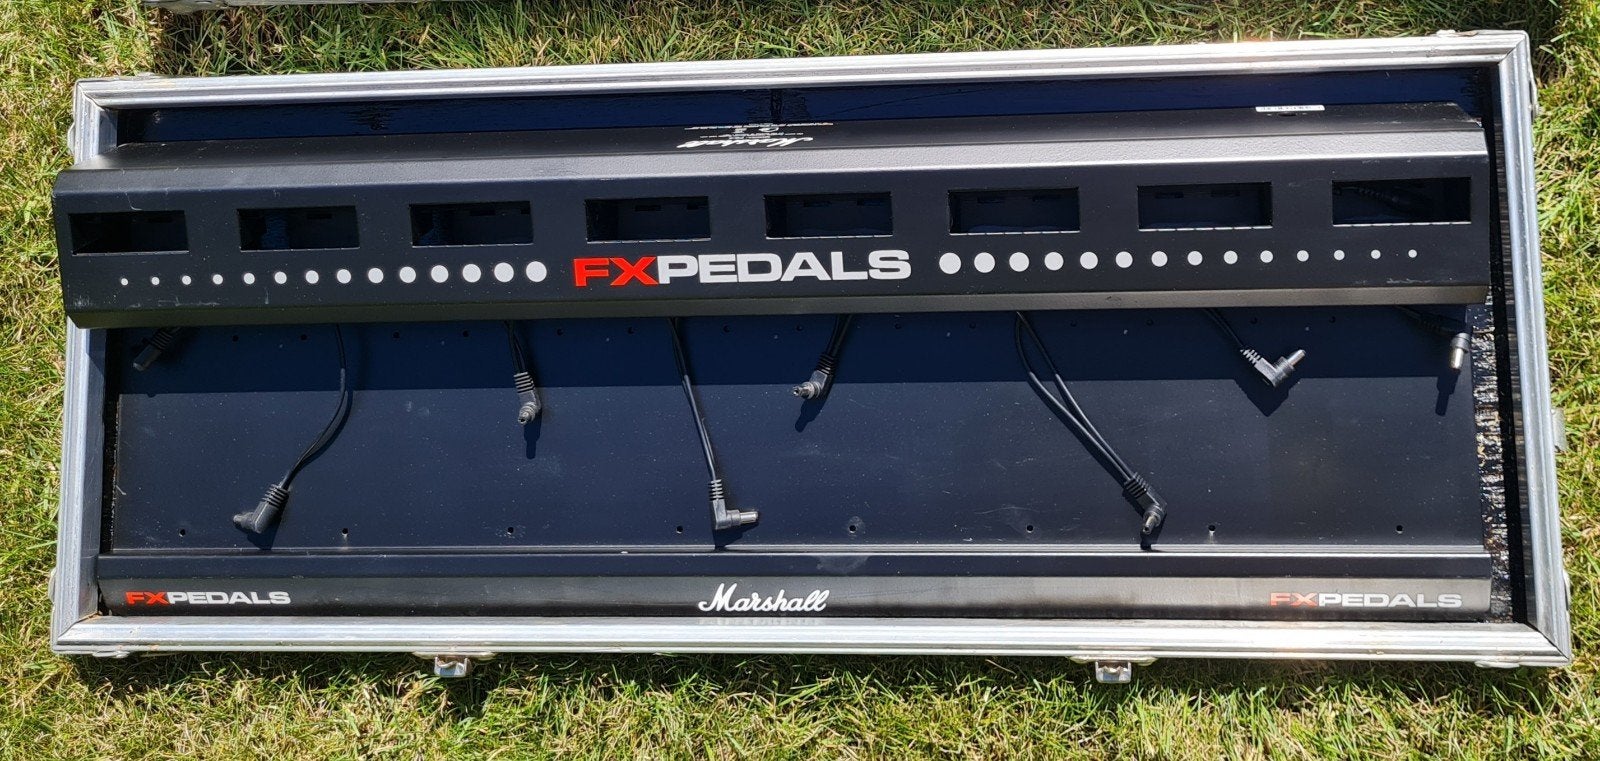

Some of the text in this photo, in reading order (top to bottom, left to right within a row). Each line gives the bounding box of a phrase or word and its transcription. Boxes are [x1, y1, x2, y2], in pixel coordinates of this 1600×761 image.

[574, 249, 911, 286] FXPEDALS
[126, 591, 291, 605] FXPEDALS
[698, 583, 830, 612] Marshall
[1270, 592, 1462, 608] FXPEDALS
